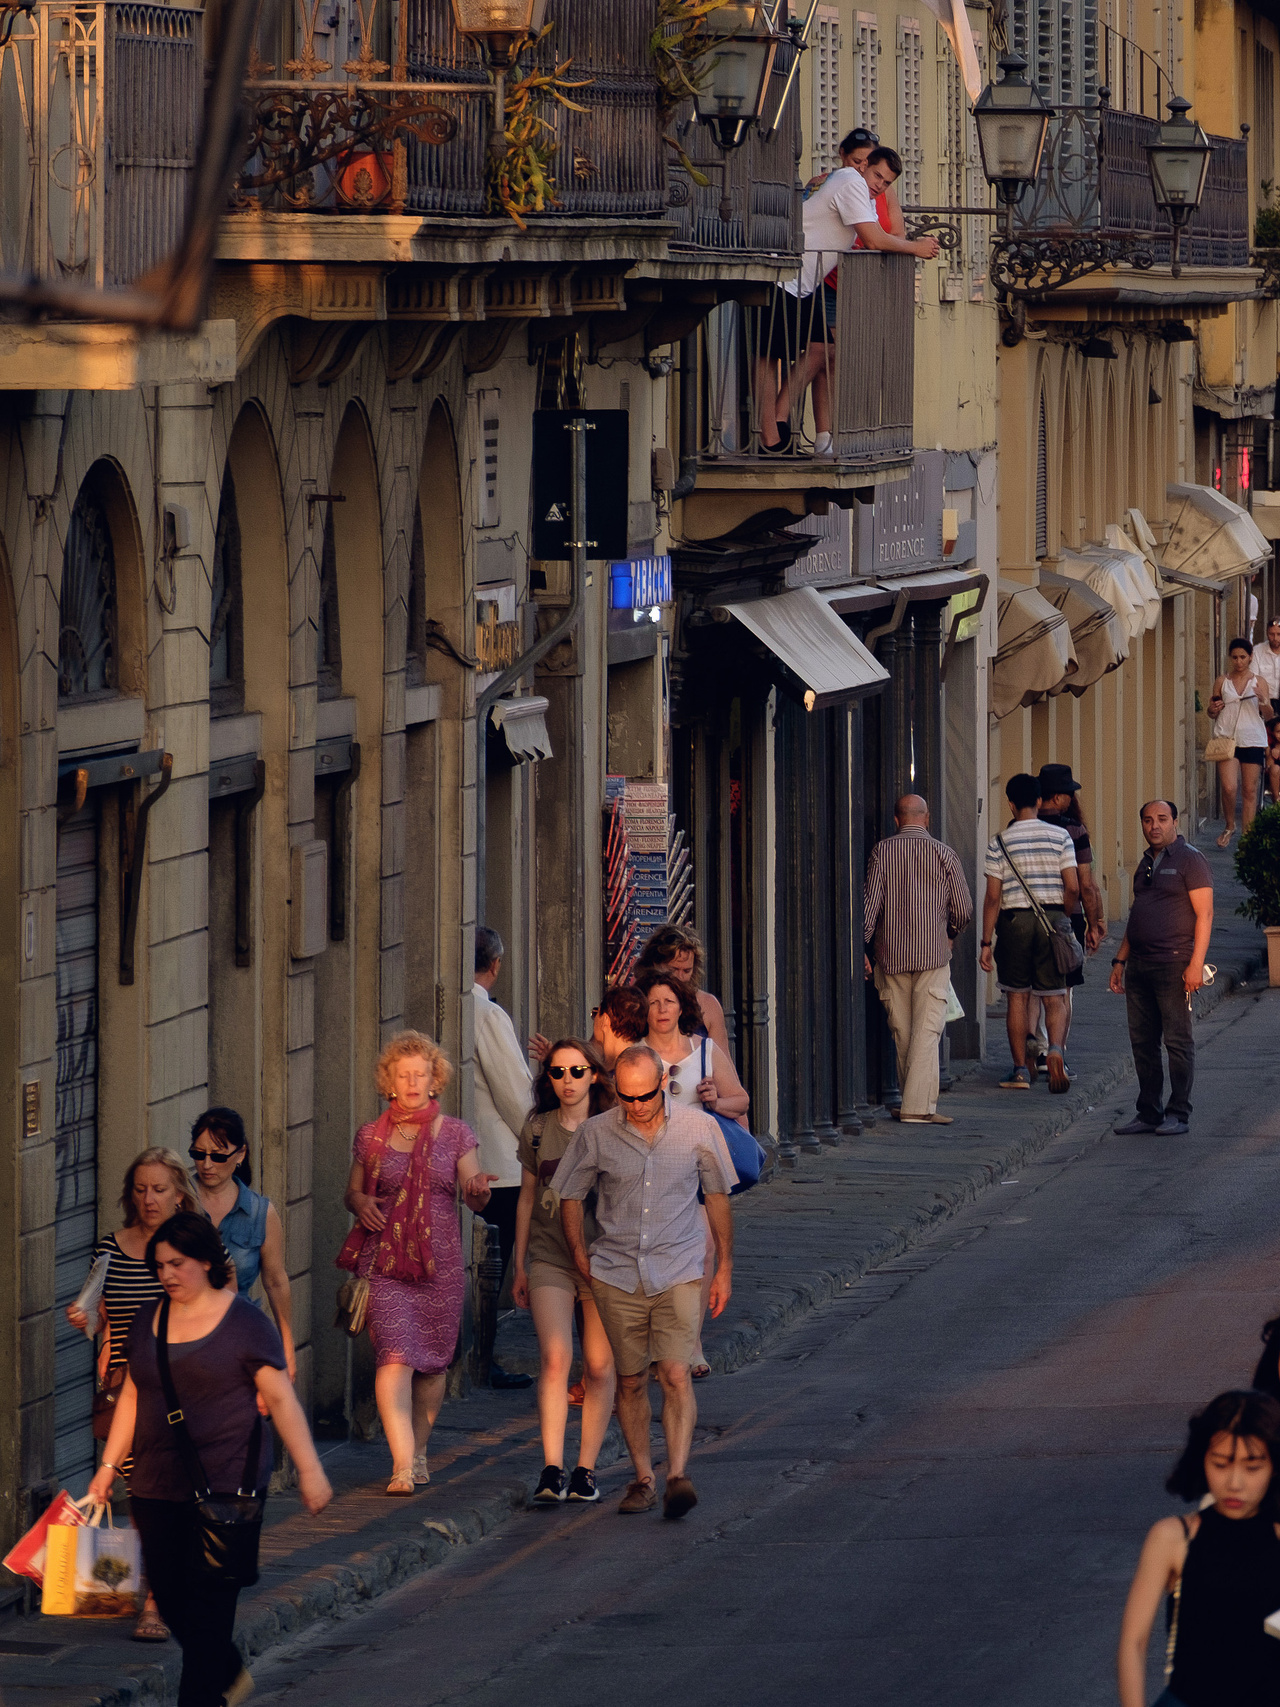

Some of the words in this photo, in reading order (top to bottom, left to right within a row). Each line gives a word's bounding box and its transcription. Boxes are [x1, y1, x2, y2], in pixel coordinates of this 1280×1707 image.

[879, 538, 926, 562] FLORENCE
[795, 551, 842, 576] FLORENCE
[630, 555, 672, 608] TABACCHI
[631, 873, 663, 881] LORENCE
